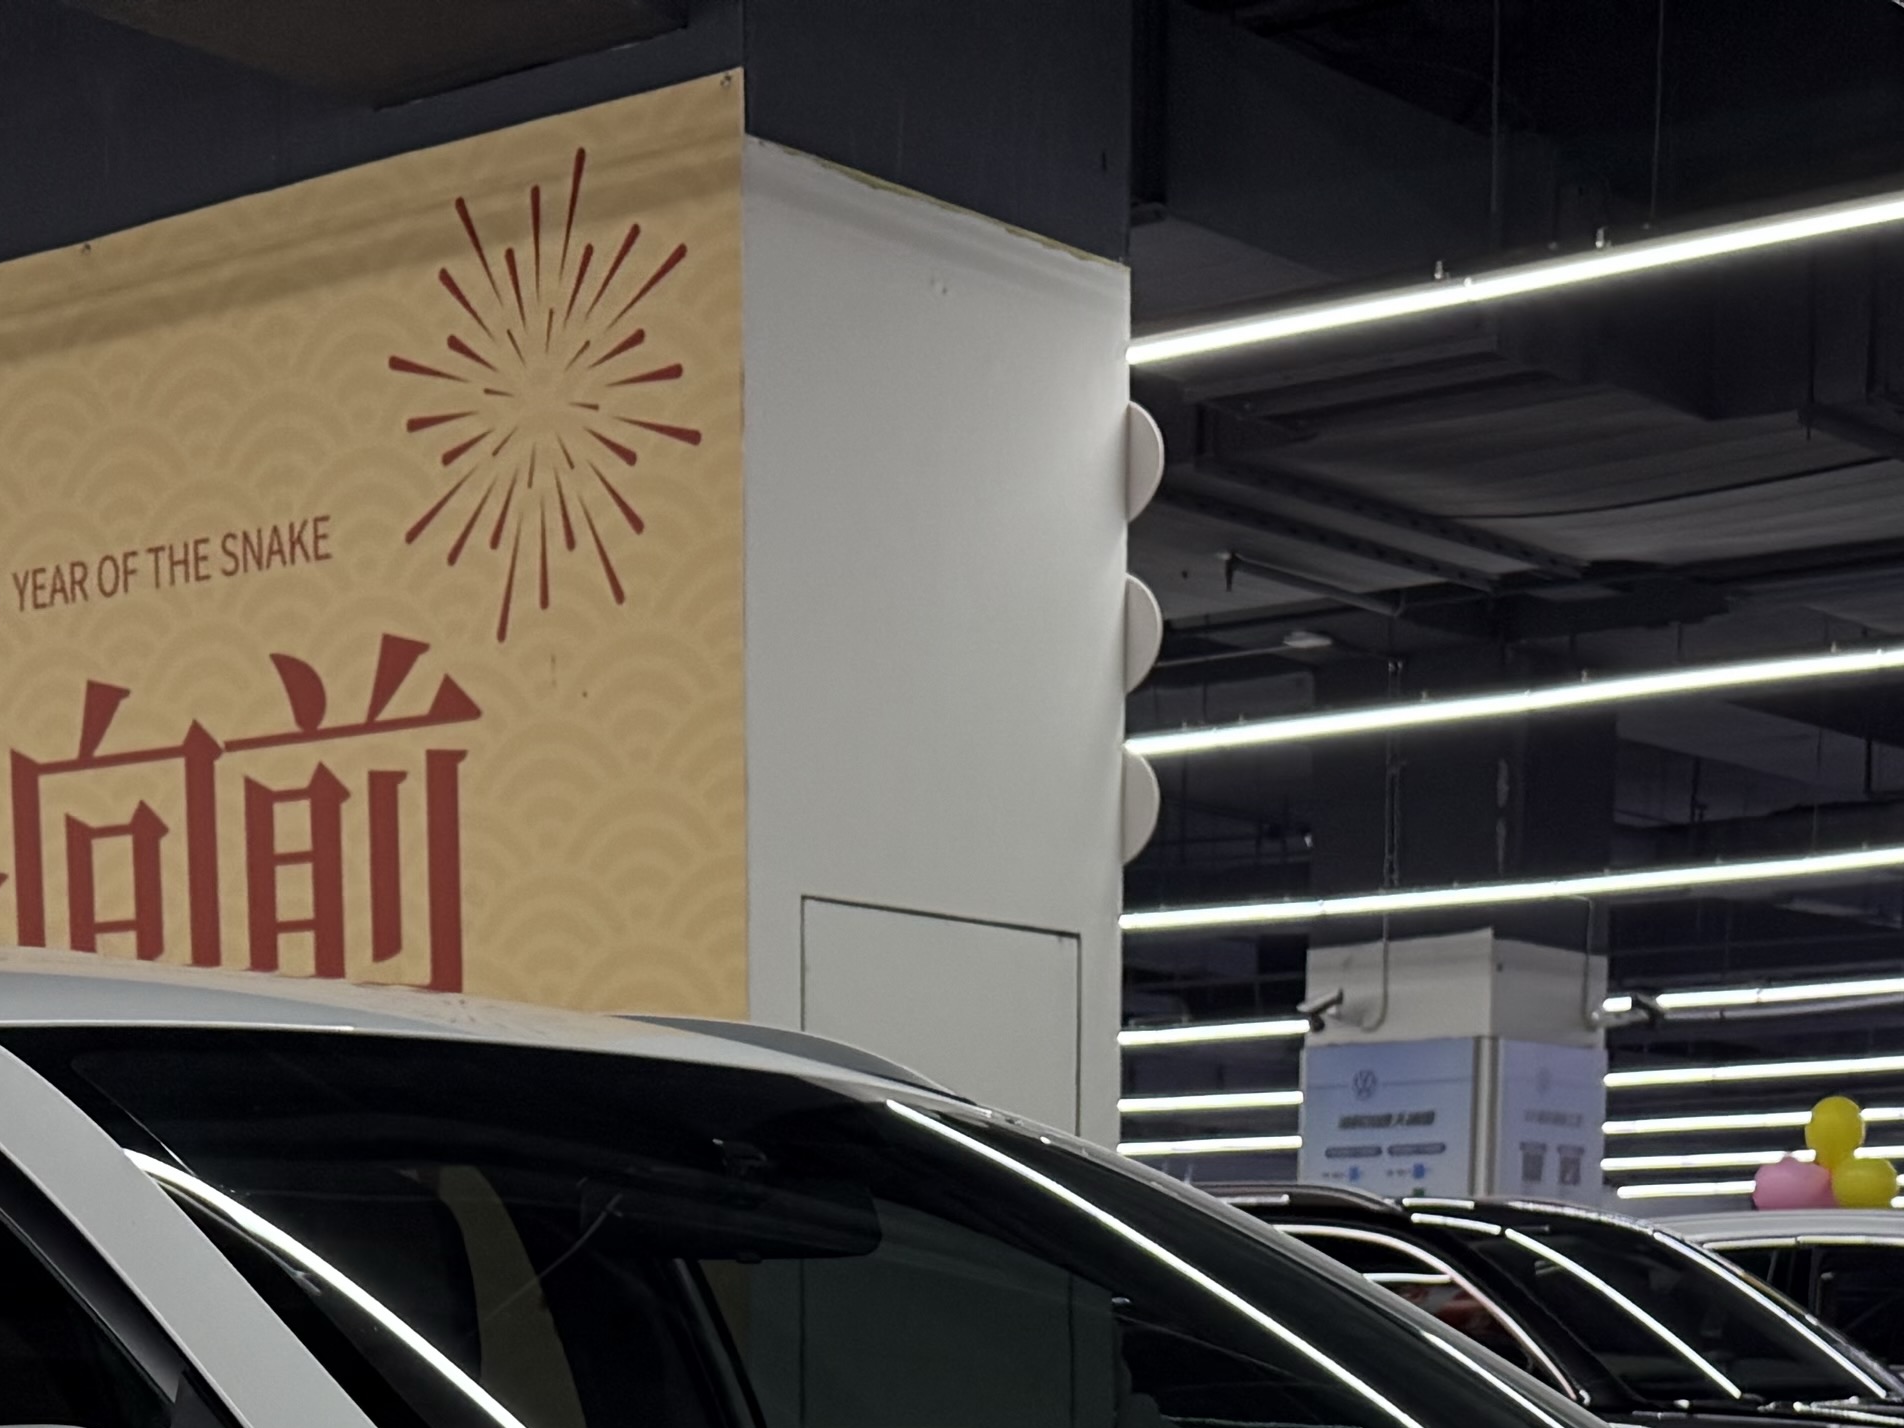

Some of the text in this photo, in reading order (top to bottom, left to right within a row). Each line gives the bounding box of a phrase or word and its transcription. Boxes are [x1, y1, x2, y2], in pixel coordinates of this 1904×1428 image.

[13, 561, 89, 611] YEAR
[97, 550, 138, 599] OF
[147, 537, 211, 589] THE
[221, 515, 332, 577] SNAKE
